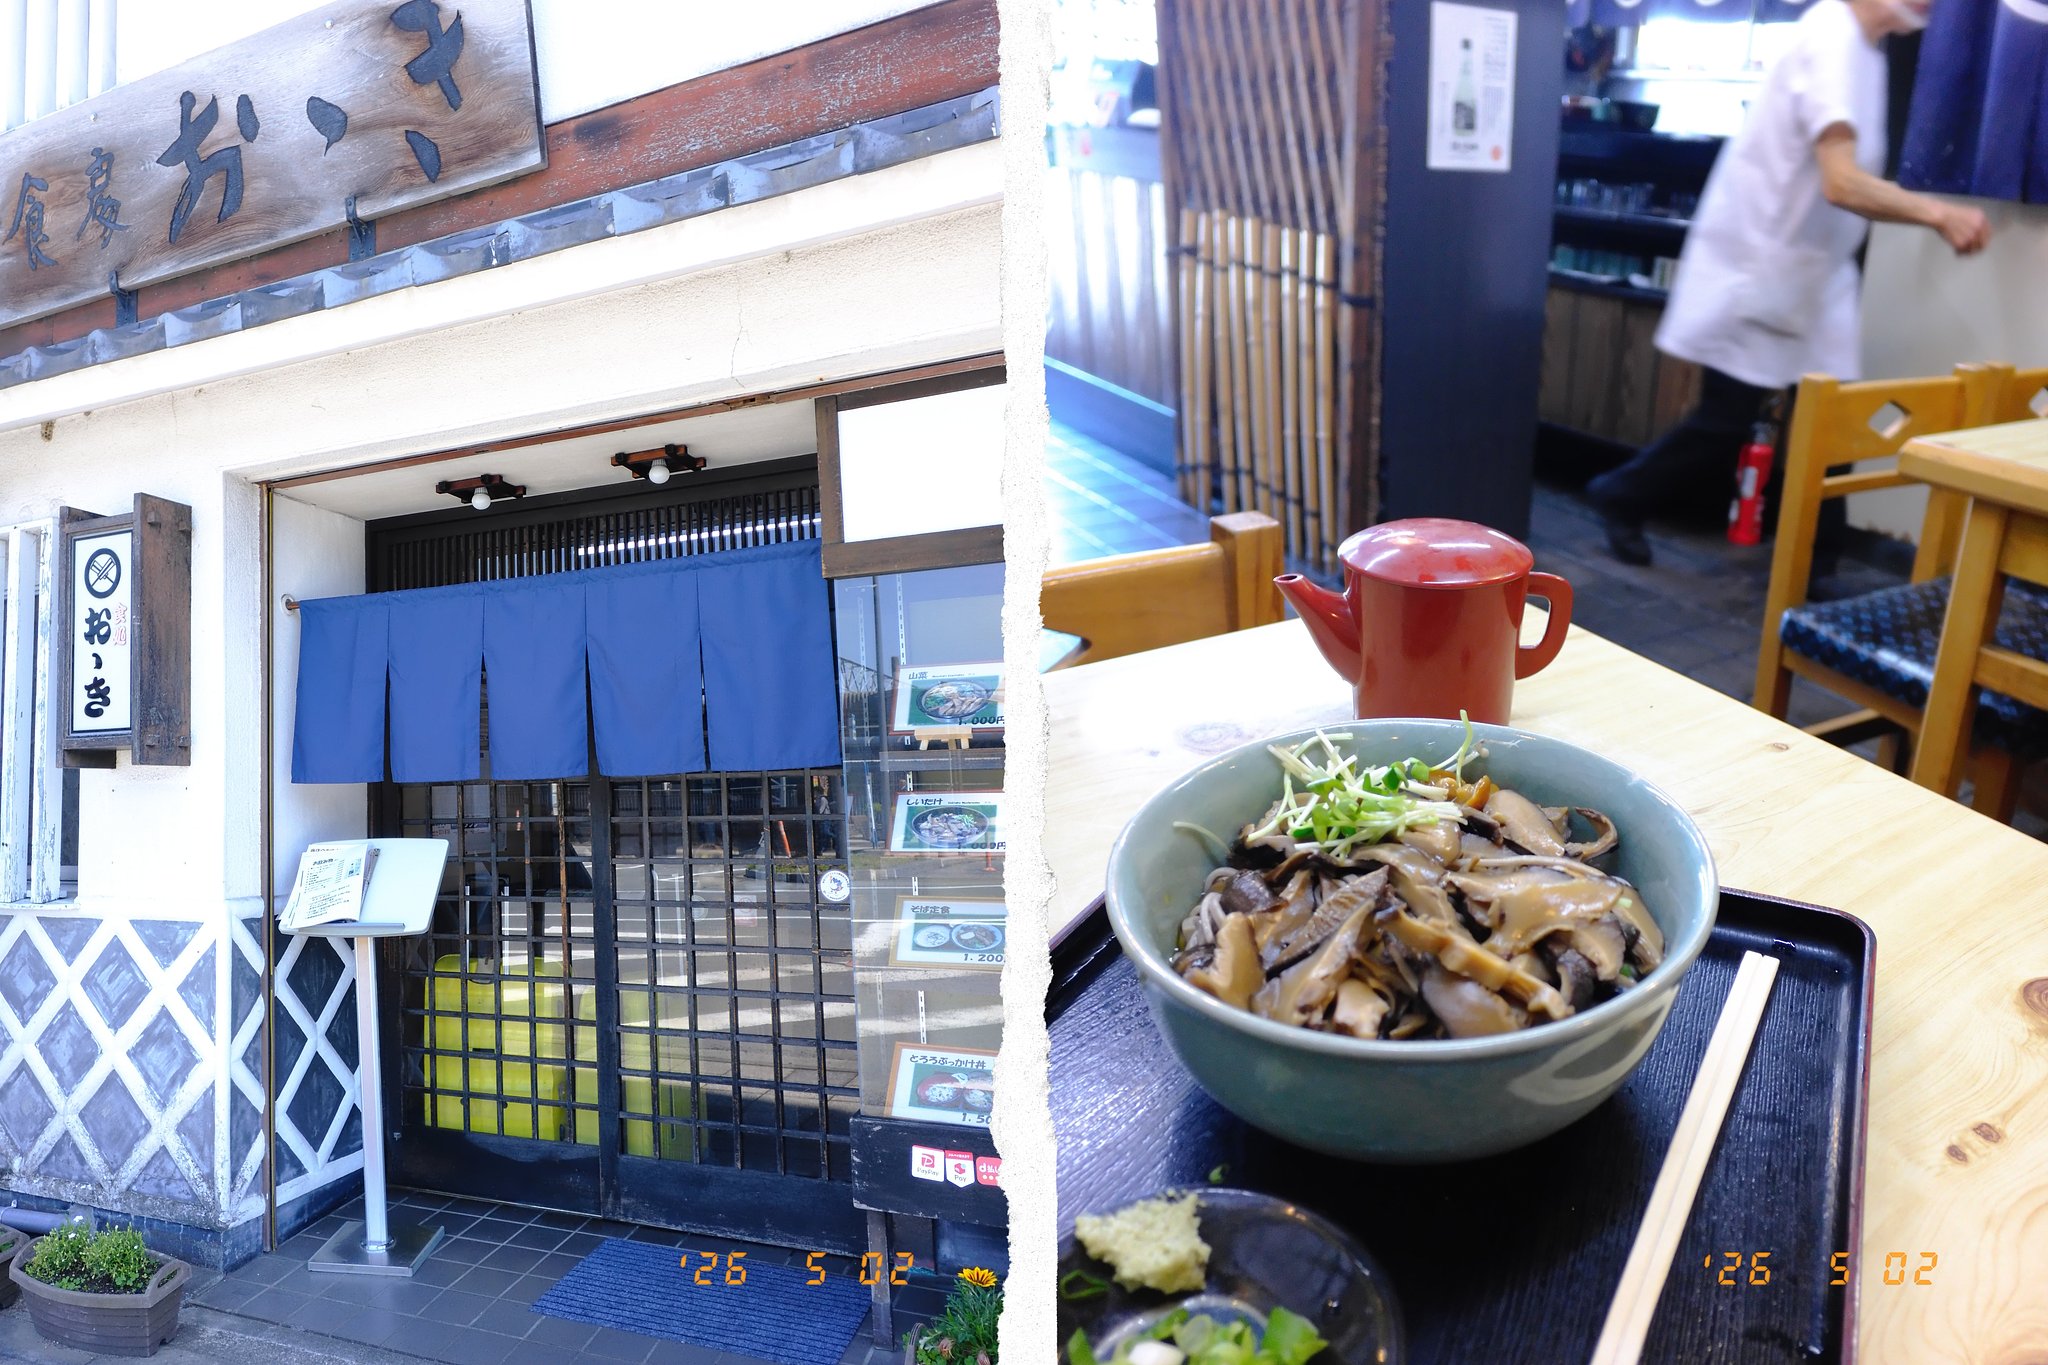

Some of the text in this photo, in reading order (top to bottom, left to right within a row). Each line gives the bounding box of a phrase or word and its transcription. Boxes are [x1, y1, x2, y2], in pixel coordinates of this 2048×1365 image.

[906, 797, 944, 806] しいたけ
[911, 905, 950, 914] そば定食
[909, 1054, 986, 1070] とろろぶっかけ丼
[917, 1166, 939, 1176] PayPay
[954, 1174, 967, 1182] Pay
